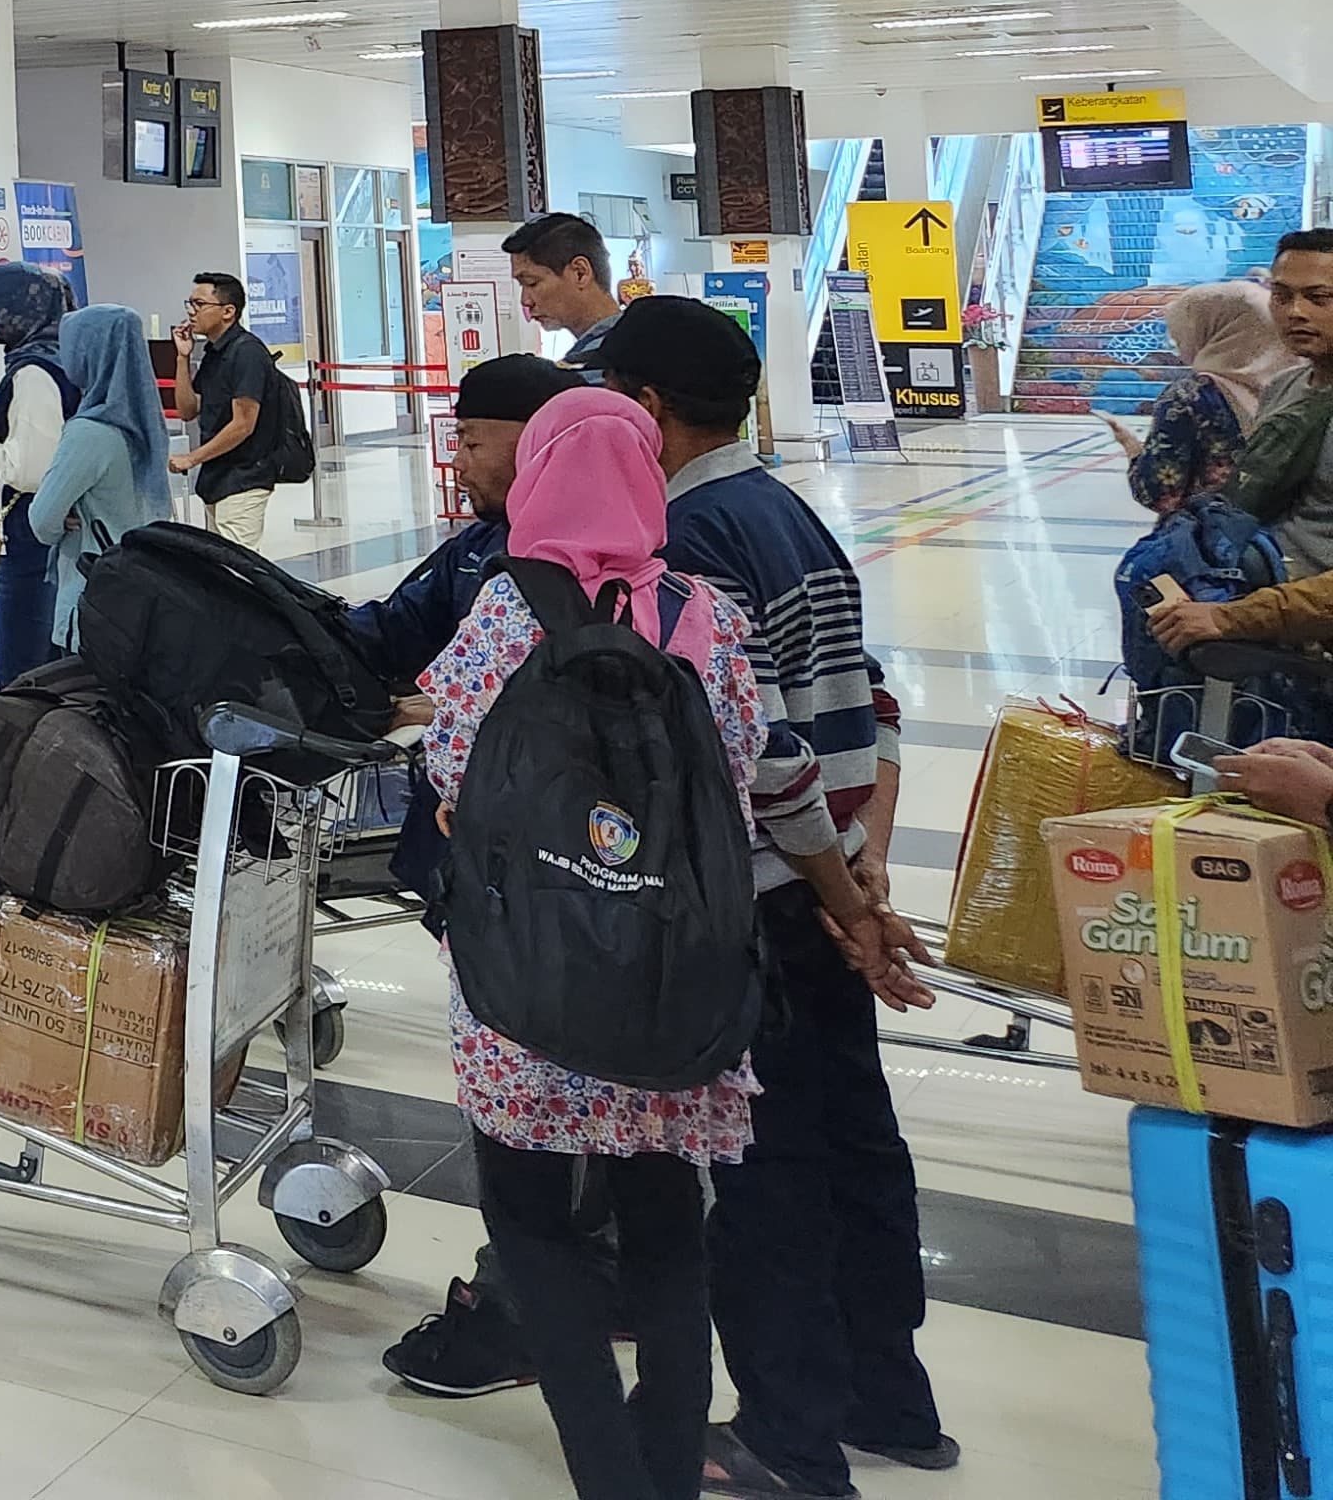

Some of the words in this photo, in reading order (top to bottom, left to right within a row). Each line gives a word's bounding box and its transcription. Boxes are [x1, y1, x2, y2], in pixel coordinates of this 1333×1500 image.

[142, 79, 161, 95] Konter
[164, 81, 171, 105] 9
[190, 88, 207, 102] Konter
[208, 88, 217, 111] 10
[1067, 95, 1146, 108] Keberangkatan
[905, 246, 949, 255] Boarding
[895, 388, 960, 406] Khusus
[579, 855, 638, 883] PROGRAM
[1071, 856, 1119, 876] Roma
[1201, 860, 1240, 877] BAG
[1081, 918, 1250, 962] Ganum
[2, 1000, 41, 1025] UNIT
[45, 1015, 67, 1034] 50
[73, 1024, 151, 1052] KUANTITS:
[1116, 1066, 1125, 1080] 4
[1141, 1071, 1150, 1084] 5
